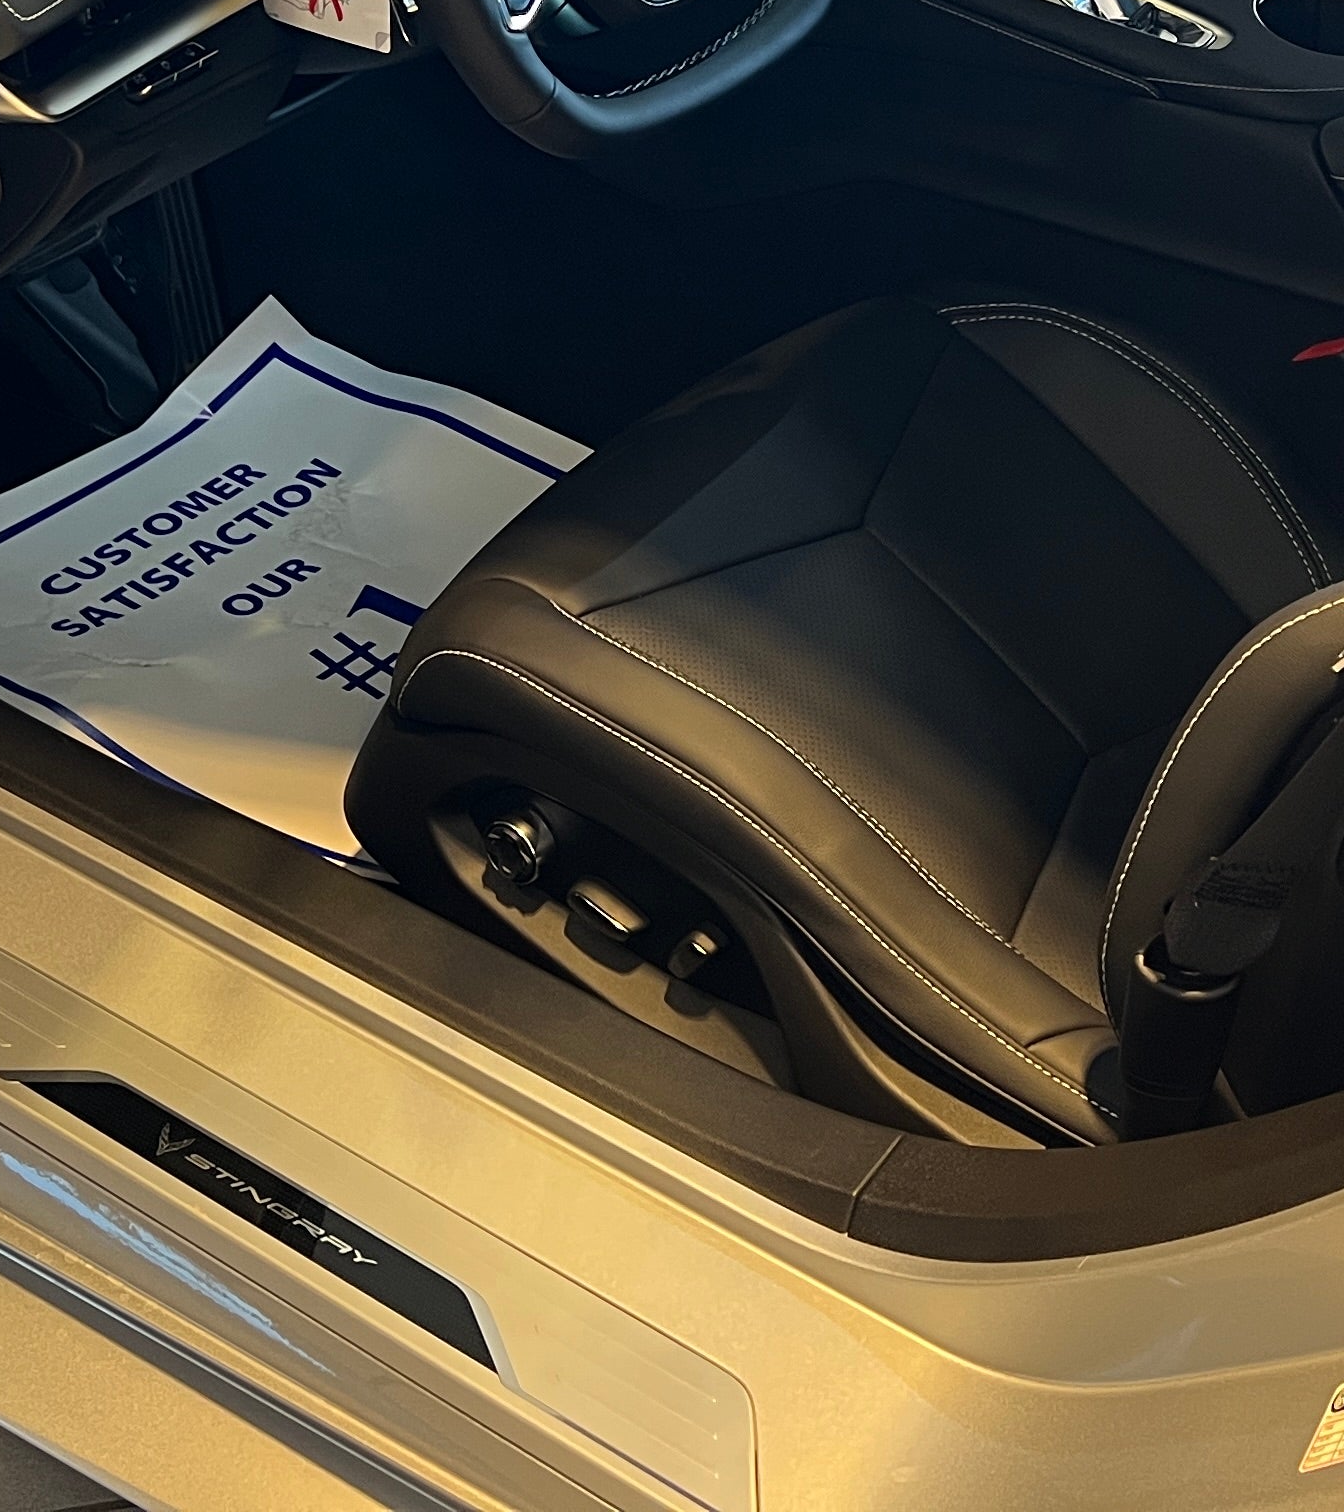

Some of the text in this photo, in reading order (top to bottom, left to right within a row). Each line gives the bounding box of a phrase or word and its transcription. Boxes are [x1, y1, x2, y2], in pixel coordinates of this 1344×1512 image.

[41, 463, 267, 595] CUSTOMER
[50, 458, 342, 637] SATISFACTION
[222, 558, 322, 616] OUR
[309, 584, 427, 700] #1
[184, 1153, 379, 1265] STINGRAY
